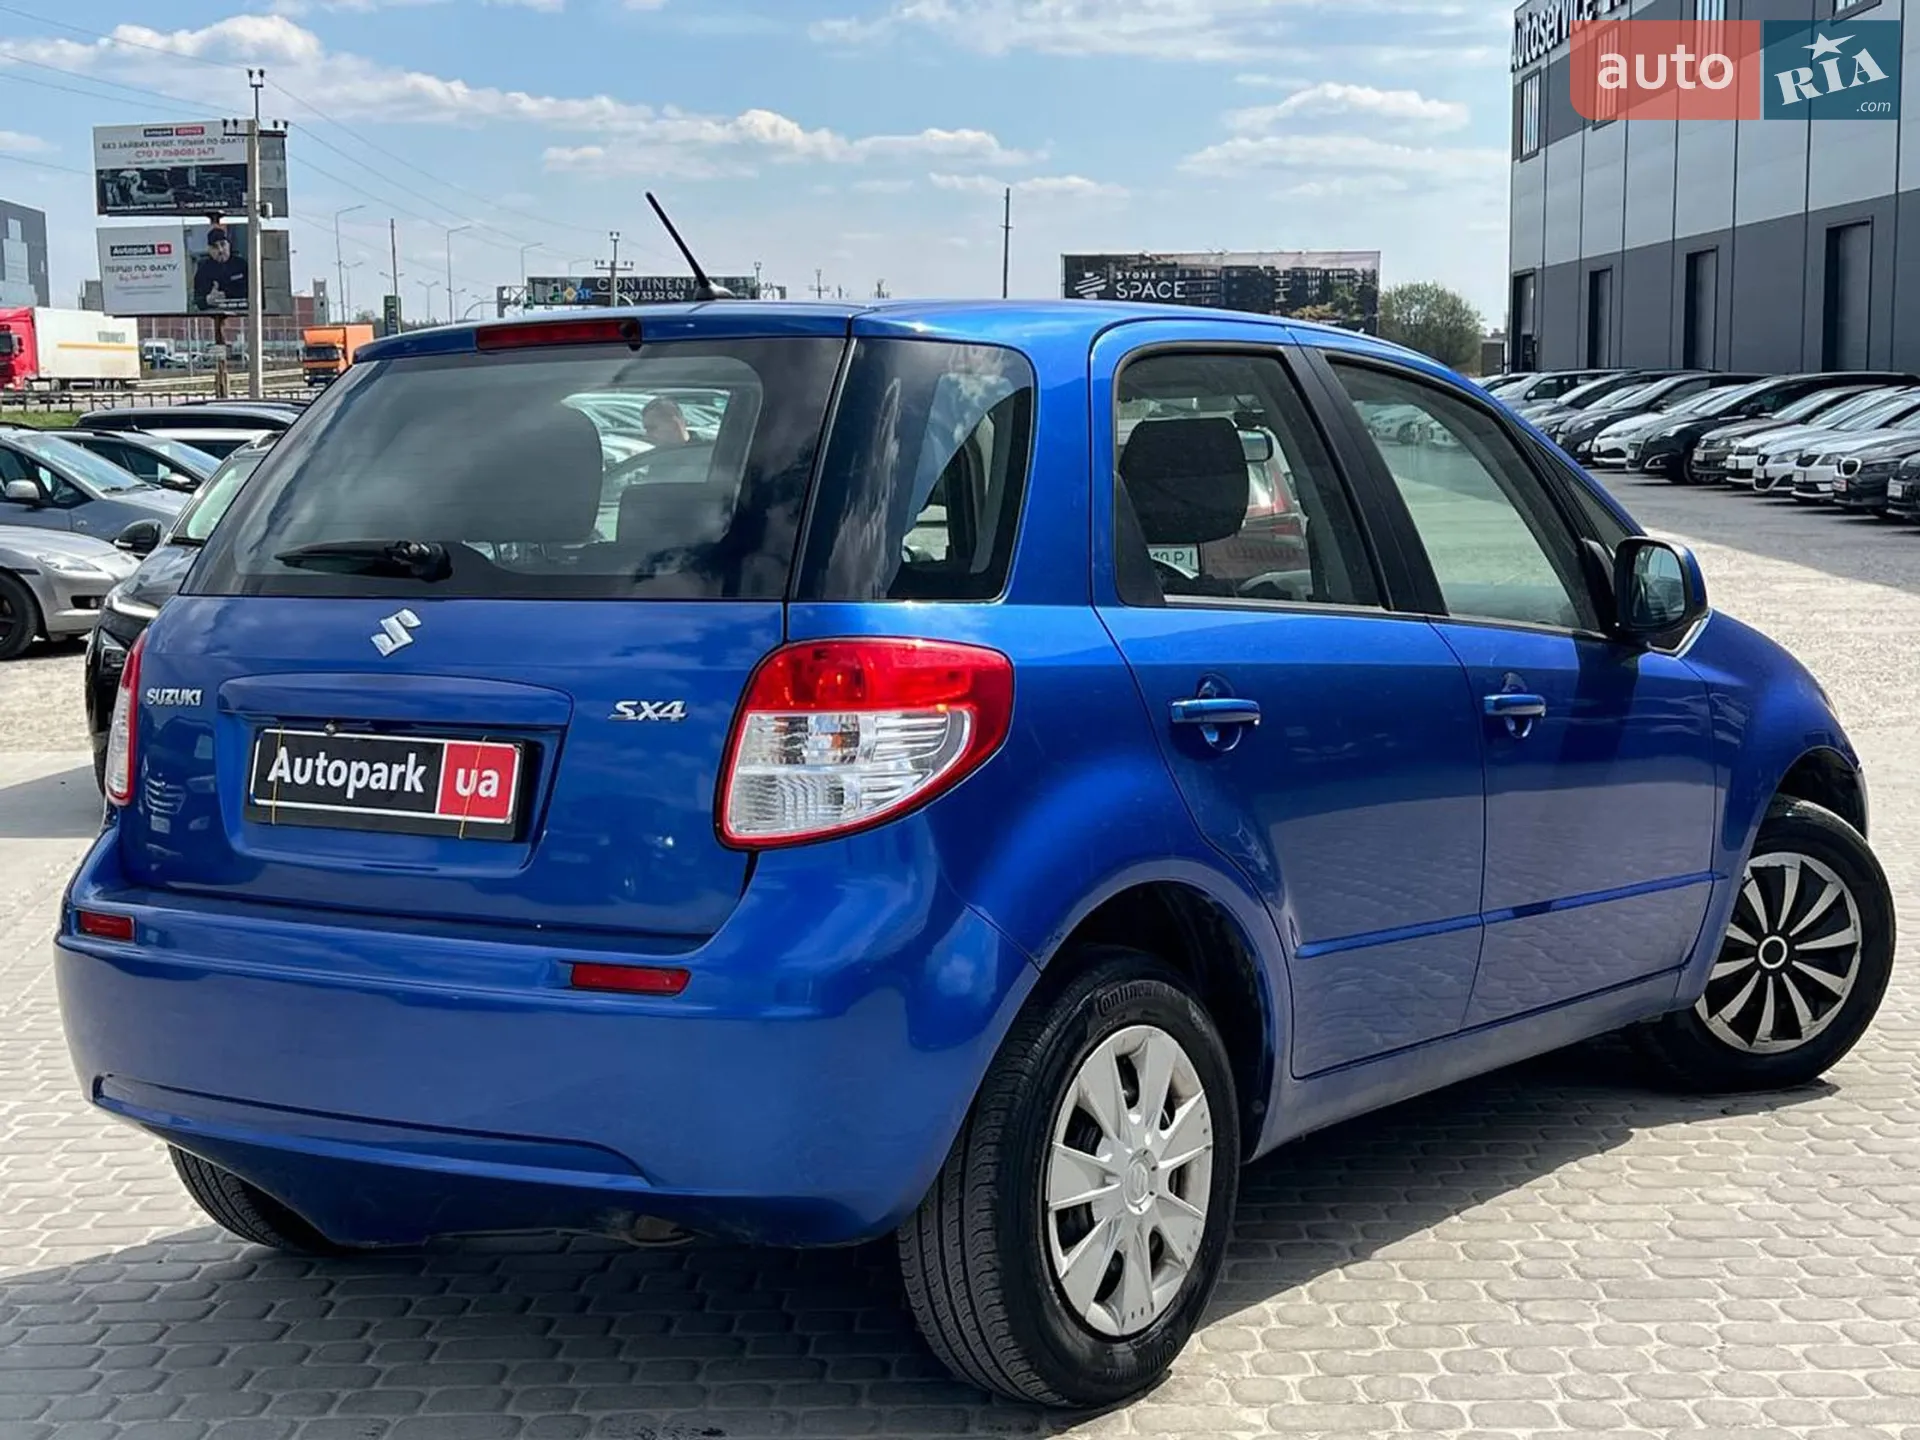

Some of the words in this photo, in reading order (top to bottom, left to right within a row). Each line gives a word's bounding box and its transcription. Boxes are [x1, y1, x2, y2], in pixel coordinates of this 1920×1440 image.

[113, 246, 153, 255] Autopark
[1116, 281, 1186, 298] SPACE
[146, 687, 203, 706] SUZUKI
[607, 700, 688, 722] SX4
[267, 746, 427, 799] Autopark
[455, 767, 499, 797] ua
